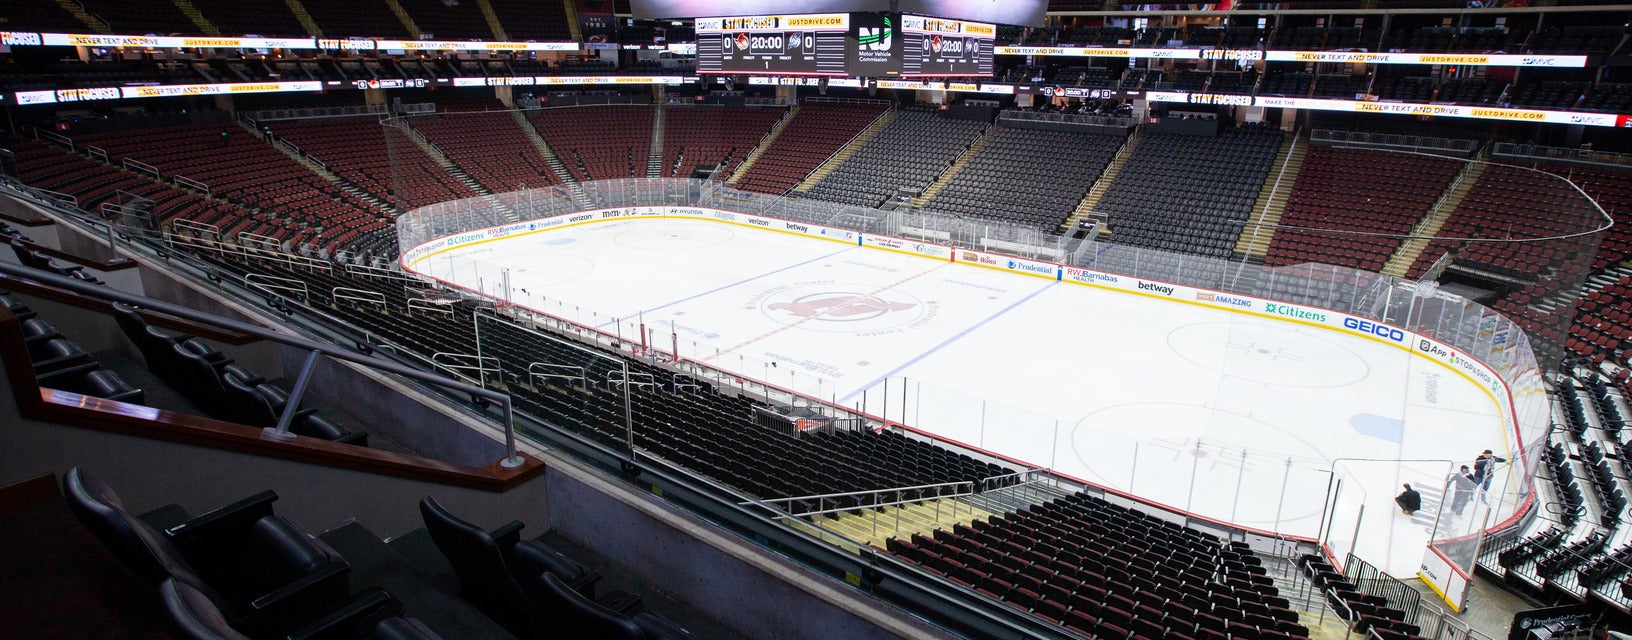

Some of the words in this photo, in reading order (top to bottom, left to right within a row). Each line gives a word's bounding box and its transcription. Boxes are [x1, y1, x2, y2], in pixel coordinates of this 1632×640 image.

[1, 32, 41, 45] FOCUSED
[805, 37, 812, 48] 0
[859, 24, 892, 50] NJ
[318, 40, 339, 50] STAY
[340, 40, 374, 50] FOCUSED
[724, 38, 730, 48] 0
[752, 37, 782, 49] 20:00
[924, 39, 928, 50] 0
[943, 40, 962, 52] 20:00
[974, 42, 978, 52] 0
[1202, 50, 1222, 59] STAY
[1224, 50, 1262, 60] FOCUSED
[58, 90, 78, 102] STAY
[80, 88, 120, 100] FOCUSED
[1191, 94, 1211, 104] STAY
[1213, 95, 1250, 105] FOCUSED
[1474, 110, 1543, 118] JUSTDRIVE.COM
[537, 218, 563, 228] Prudential
[569, 214, 592, 222] verizon
[749, 218, 768, 226] verizon
[488, 223, 526, 236] RWJBarnabas
[786, 223, 808, 232] betway
[454, 233, 484, 244] Citizens
[980, 256, 996, 265] Wawa
[1018, 263, 1052, 274] Prudential
[1067, 268, 1118, 283] RWJBarnabas
[1138, 281, 1174, 296] betway
[1216, 296, 1251, 307] AMAZING
[1278, 305, 1326, 322] Citizens
[1344, 317, 1404, 342] GEICO
[1430, 345, 1447, 357] App
[1455, 357, 1492, 384] STOP&SHOP
